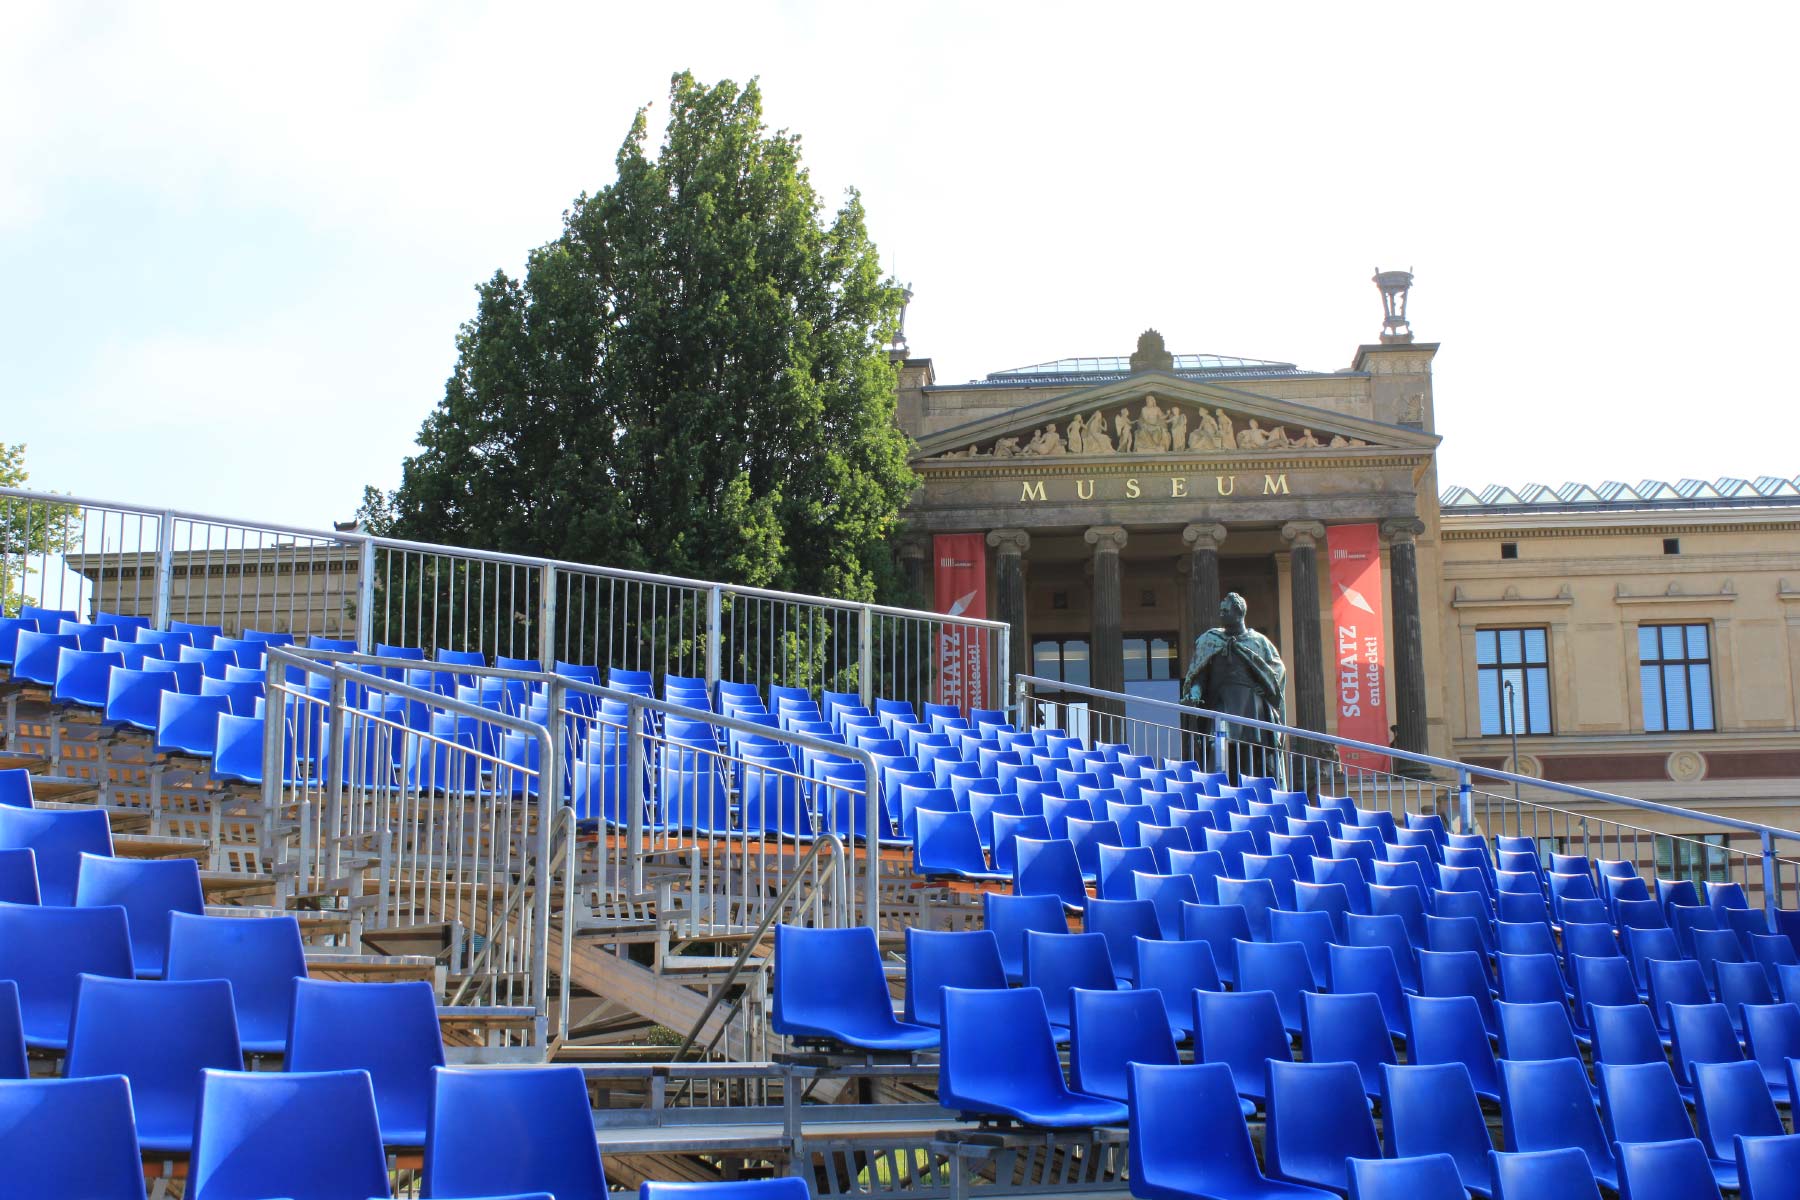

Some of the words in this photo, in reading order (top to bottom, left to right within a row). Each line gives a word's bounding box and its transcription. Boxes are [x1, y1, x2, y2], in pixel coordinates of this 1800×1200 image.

[1020, 474, 1290, 501] MUSEUM
[942, 633, 961, 706] CHATZ
[967, 644, 982, 708] ntdeckt!
[1339, 625, 1361, 717] SCHATZ
[1364, 636, 1380, 706] entdeckt!
